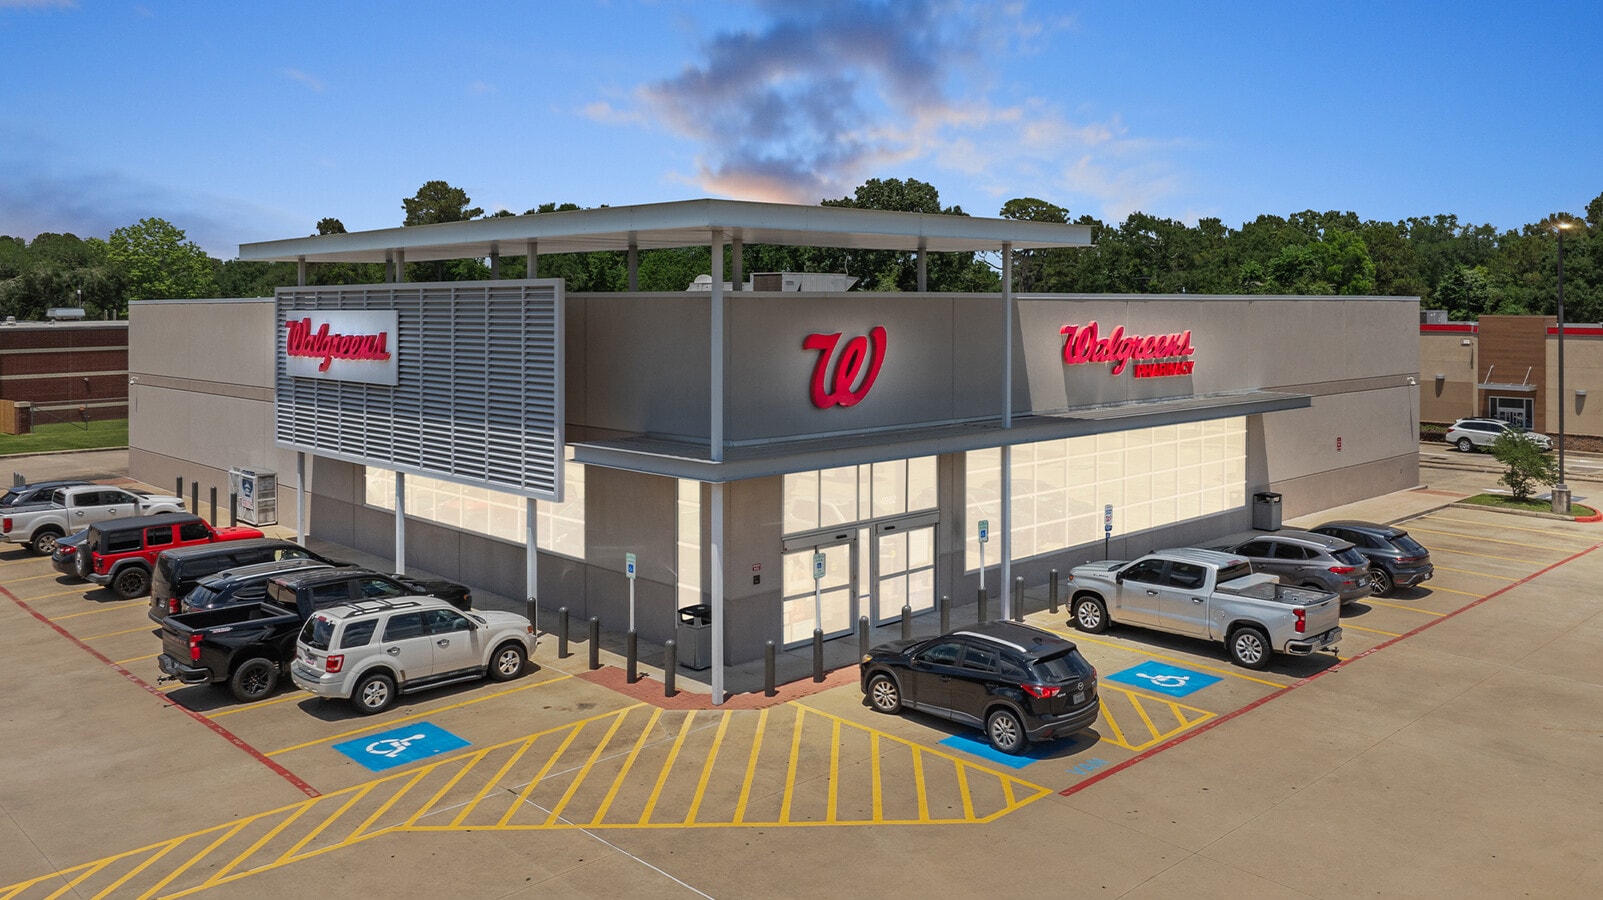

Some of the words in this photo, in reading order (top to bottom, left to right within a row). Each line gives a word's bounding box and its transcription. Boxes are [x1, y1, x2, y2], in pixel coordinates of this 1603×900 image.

[285, 317, 391, 372] Walgreens
[802, 325, 887, 409] W
[1059, 320, 1195, 375] Walgreens
[1133, 361, 1195, 378] PHARMACY
[1065, 757, 1111, 776] VAN
